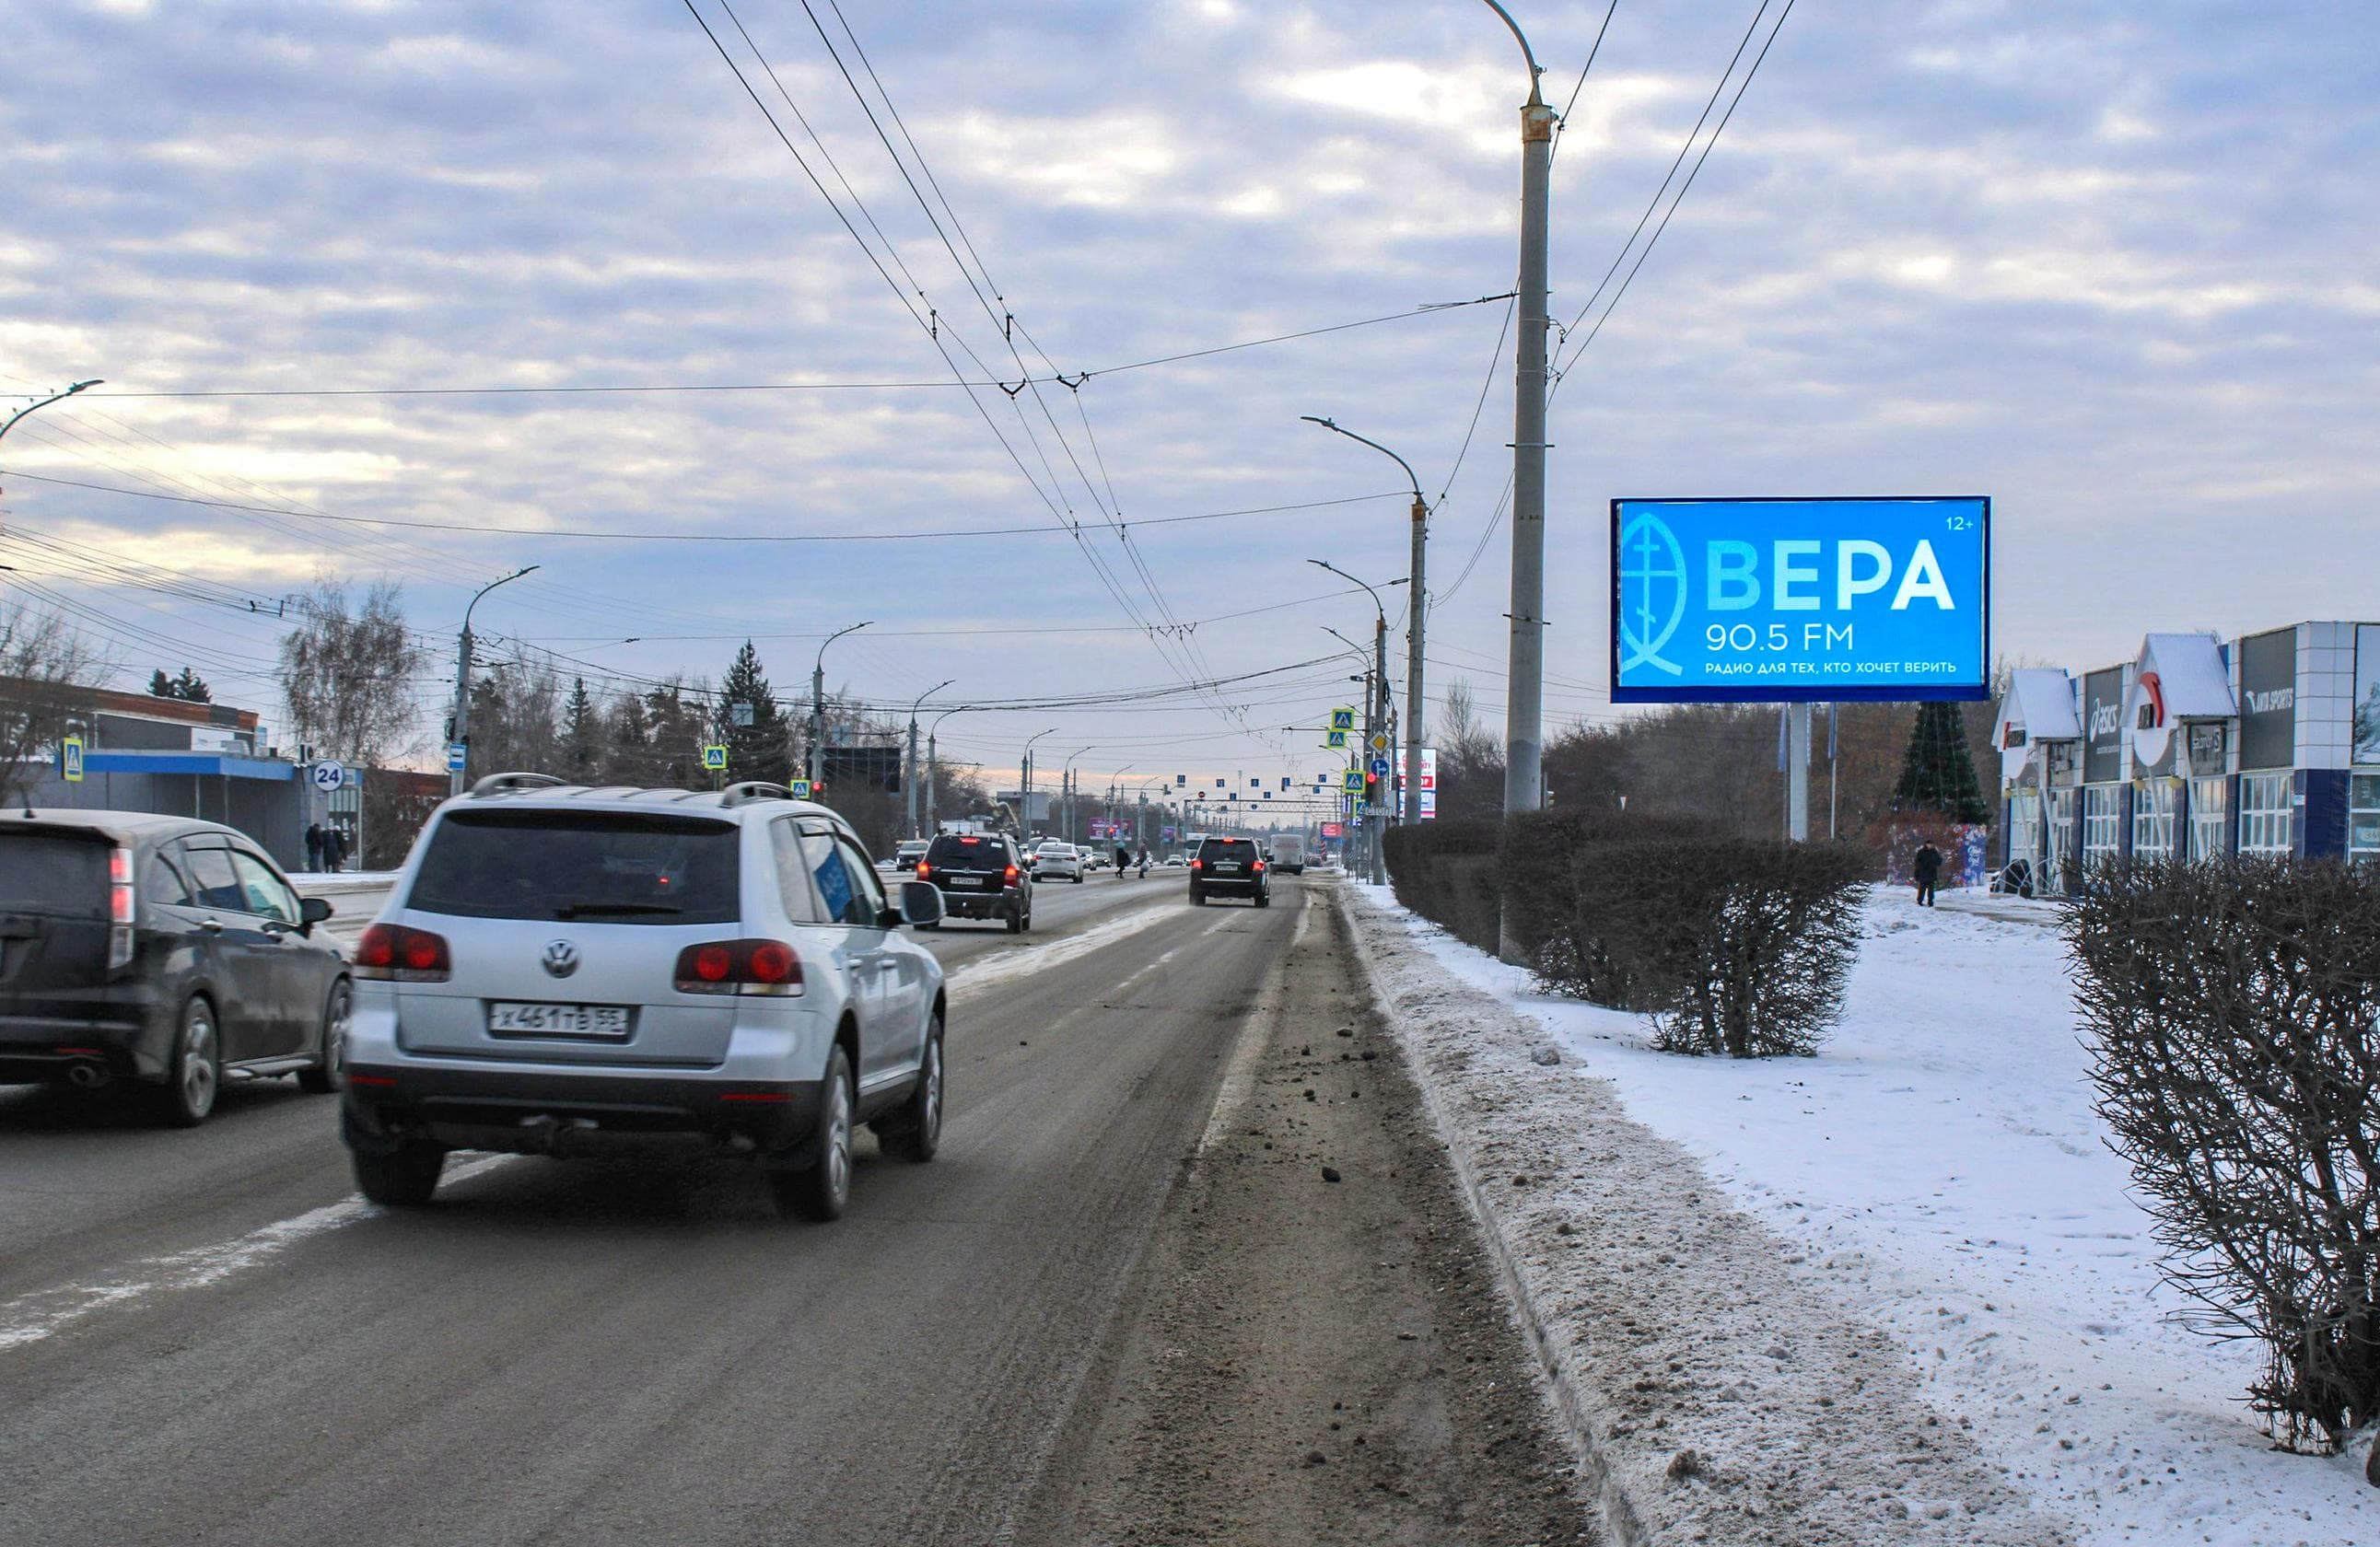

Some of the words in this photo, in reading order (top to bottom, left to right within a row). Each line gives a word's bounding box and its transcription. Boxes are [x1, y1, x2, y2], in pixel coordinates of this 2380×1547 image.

[1945, 516, 1974, 530] 12+
[1707, 539, 1956, 611] ВЕРА
[1706, 623, 1789, 651] 90.5
[1804, 622, 1854, 650] FM
[1705, 662, 1754, 675] РАДИО
[1756, 662, 1786, 675] ДЛЯ
[1791, 662, 1820, 675] ТЕХ,
[1824, 662, 1851, 674] КТО
[1856, 661, 1900, 673] ХОЧЕТ
[1904, 661, 1956, 674] ВЕРИТЬ
[317, 768, 340, 784] 24
